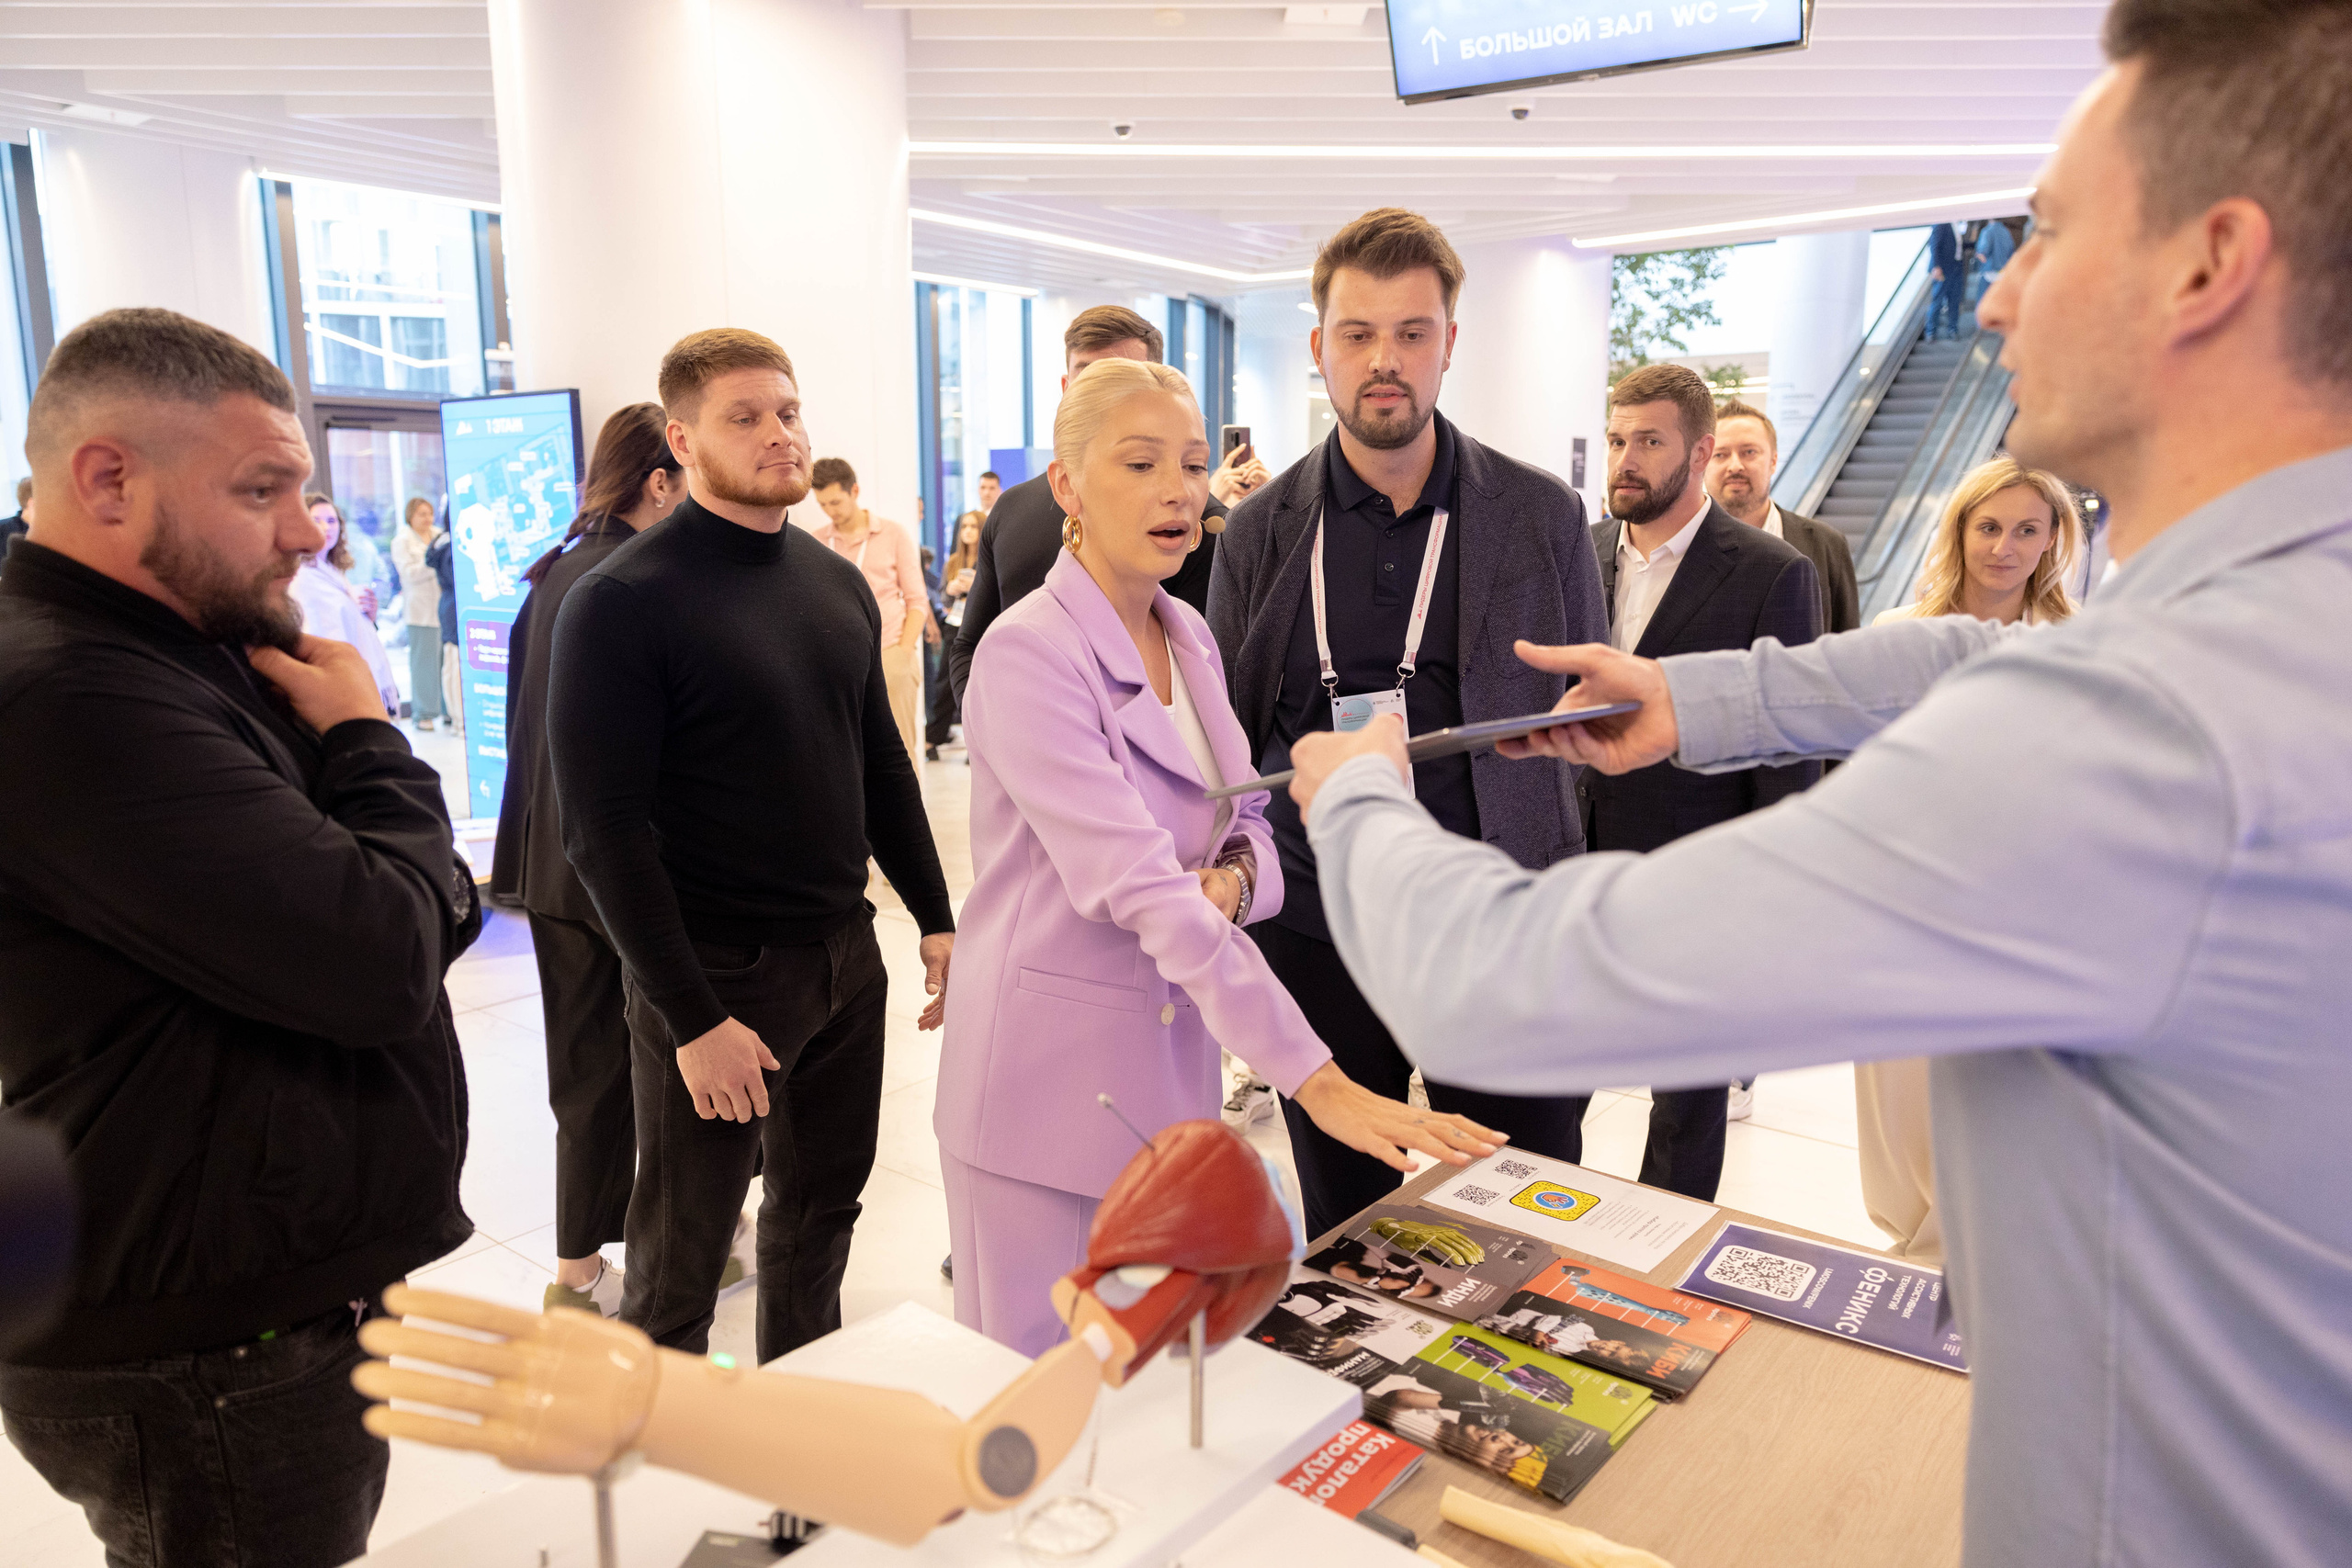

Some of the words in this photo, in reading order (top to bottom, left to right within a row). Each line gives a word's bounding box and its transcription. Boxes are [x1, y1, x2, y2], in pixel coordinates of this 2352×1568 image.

[1670, 1, 1718, 28] WC
[1459, 15, 1591, 60] БОЛЬШОЙ
[1598, 10, 1653, 39] ЗАЛ
[1437, 1277, 1481, 1308] ИНДИ
[1835, 1267, 1894, 1334] ФЕНИКС
[1887, 1275, 1912, 1311] ТЕХНОЛОГИЙ
[1901, 1278, 1927, 1319] АССИСТИВНЫХ
[1928, 1281, 1942, 1302] ЦЕНТР
[1327, 1351, 1371, 1377] МАНИФЕ
[1645, 1342, 1691, 1380] КИБИ
